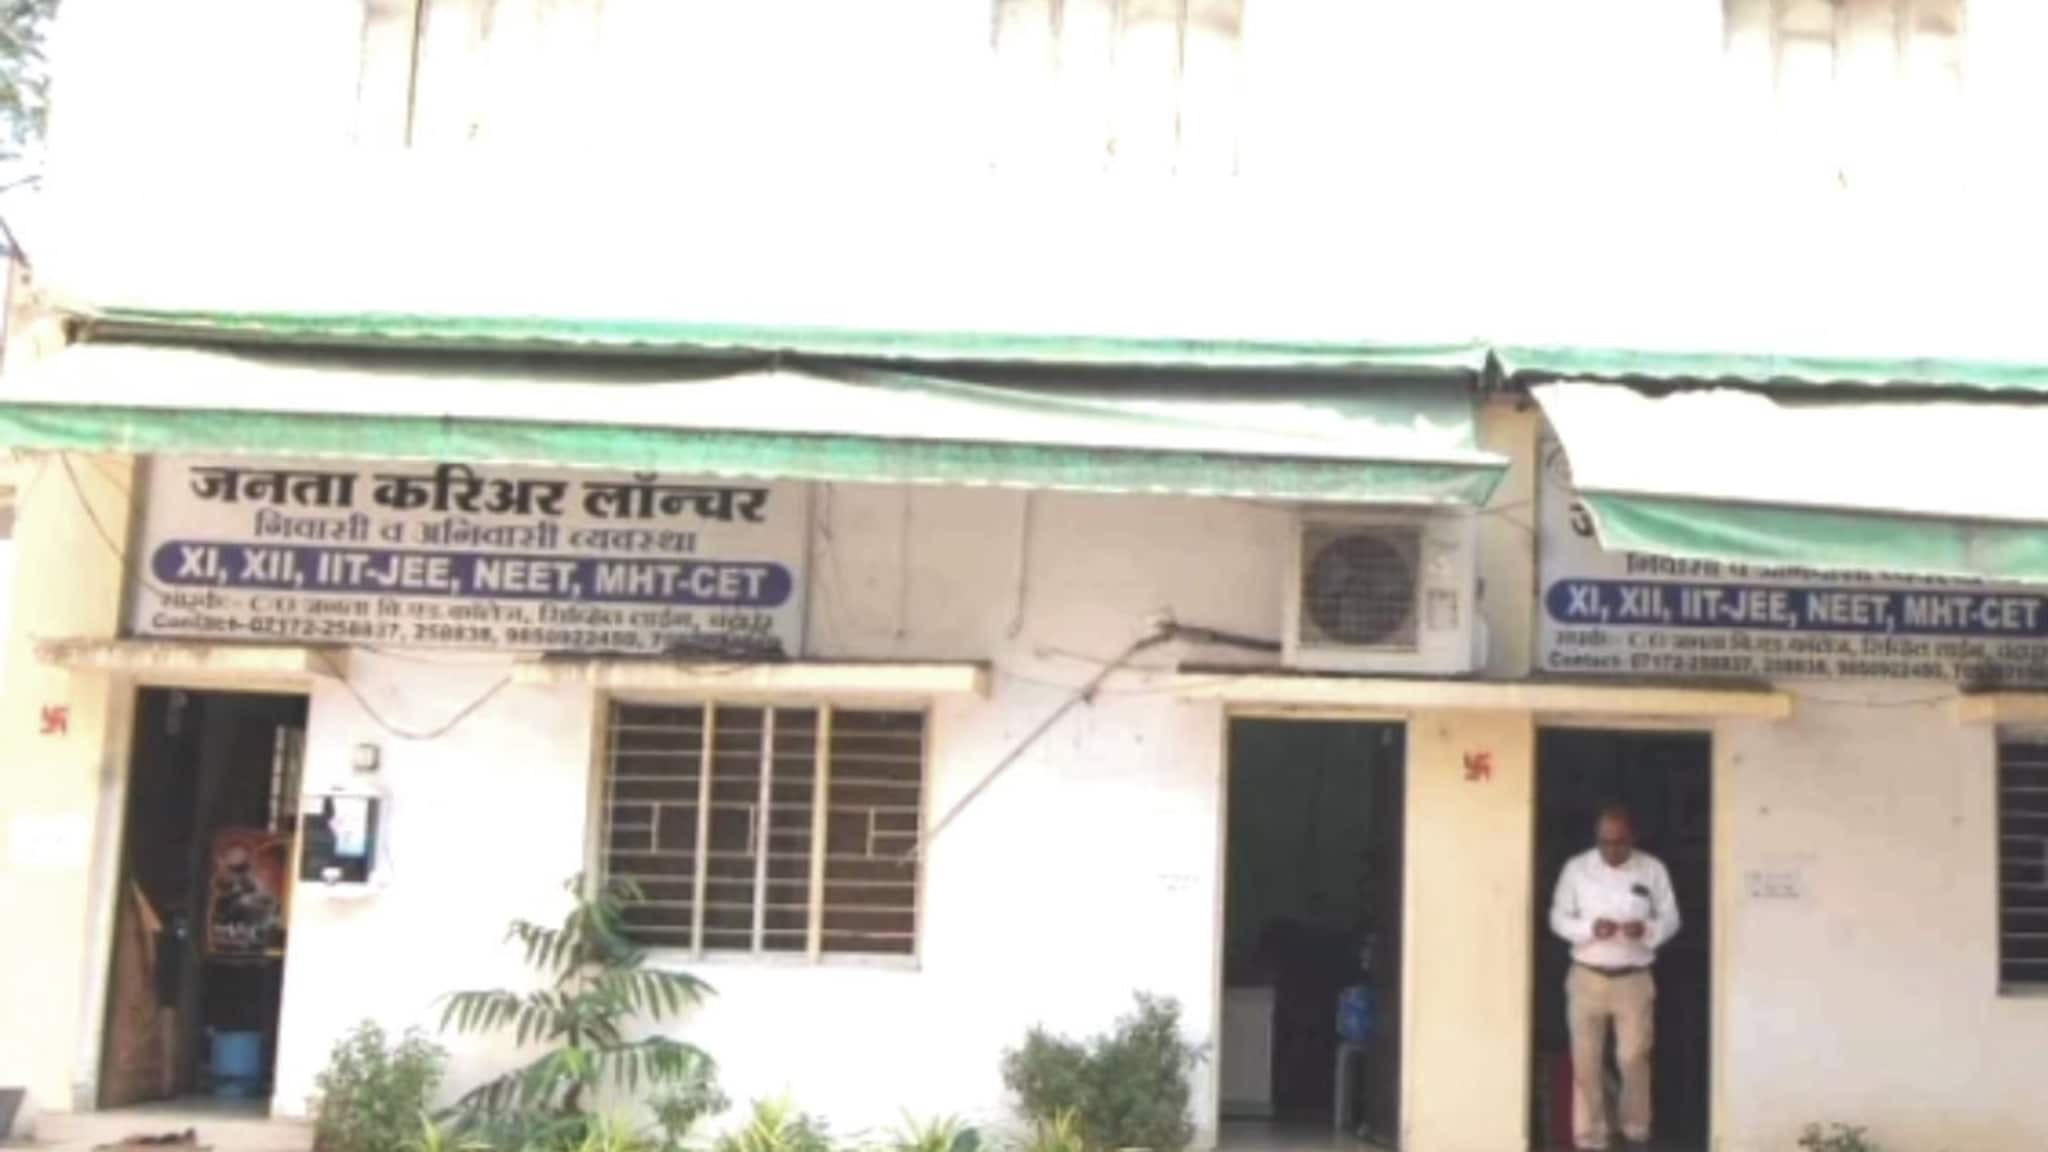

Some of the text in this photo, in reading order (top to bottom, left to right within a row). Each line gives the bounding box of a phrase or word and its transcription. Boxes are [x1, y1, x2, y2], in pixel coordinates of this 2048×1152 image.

[189, 462, 769, 523] जनता करिअर लॉन्चर
[176, 546, 769, 598] XI, XII, IIT-JEE, NEET, MHT-CET
[1567, 585, 2041, 634] XI, XII, IIT-JEE, NEET, MHT-CET
